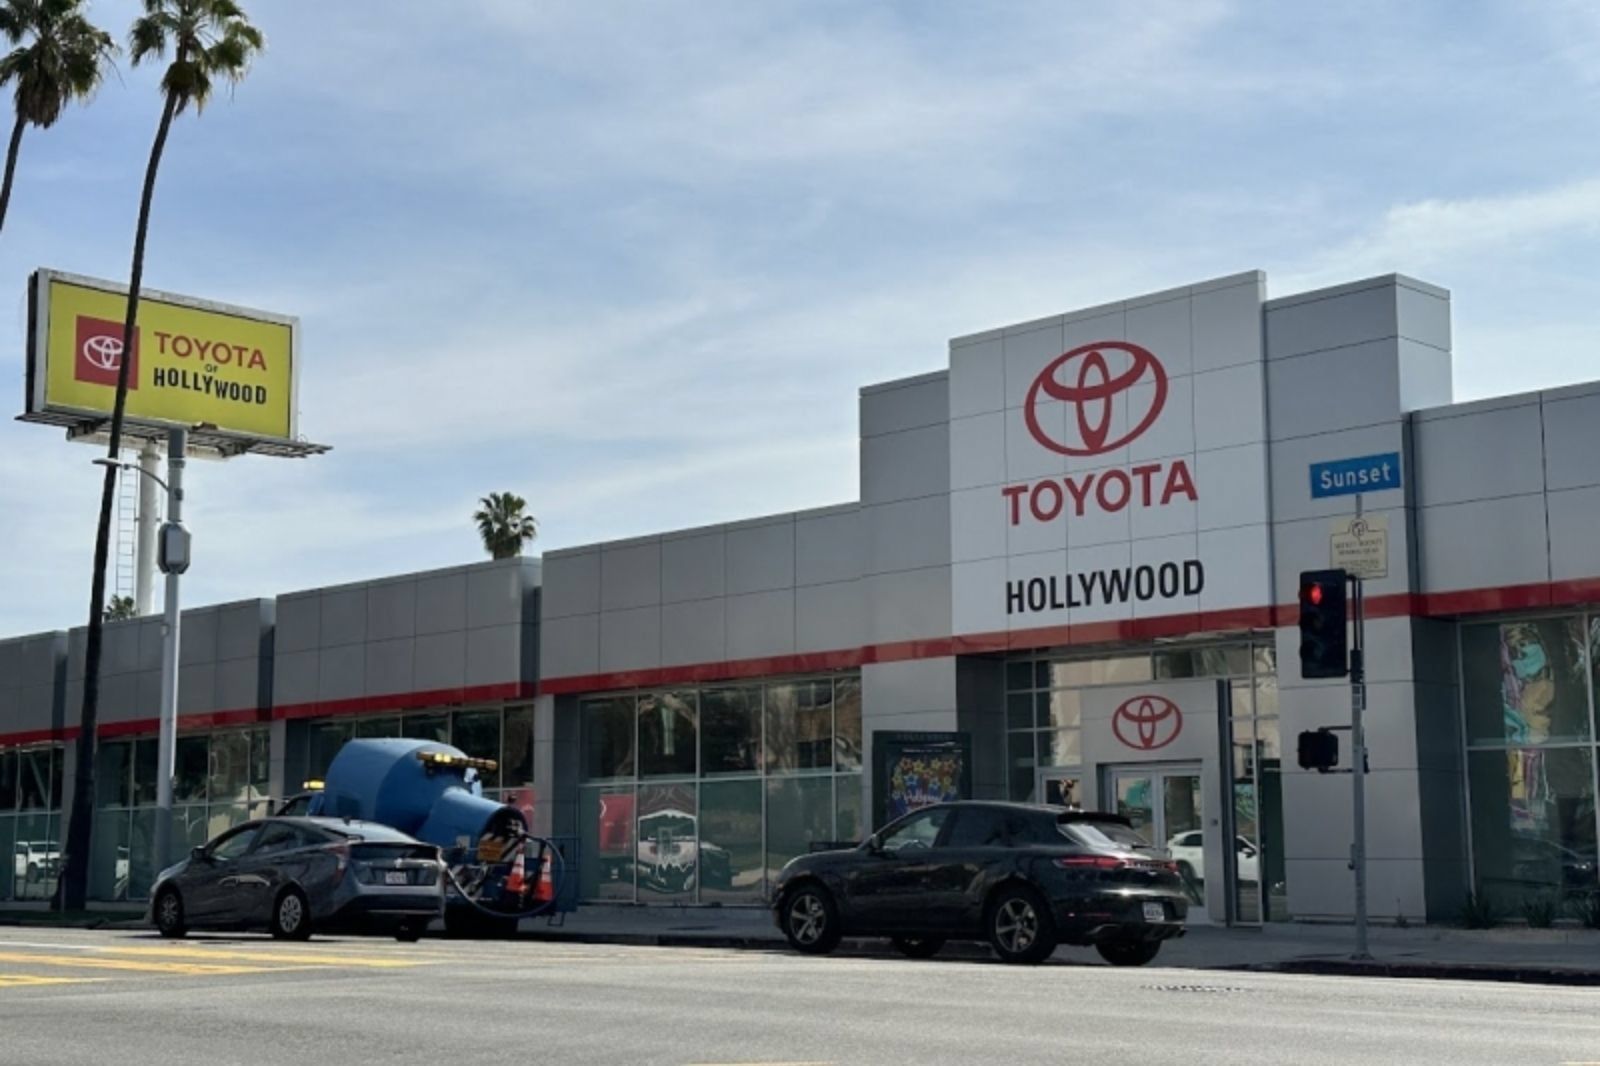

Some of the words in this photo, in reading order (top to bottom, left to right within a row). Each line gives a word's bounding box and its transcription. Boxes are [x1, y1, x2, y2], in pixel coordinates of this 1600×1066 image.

[154, 332, 267, 370] TOYOTA
[153, 367, 267, 405] HOLLYWOOD
[1002, 460, 1198, 526] TOYOTA
[1321, 462, 1391, 489] Sunset
[1006, 560, 1205, 614] HOLLYWOOD
